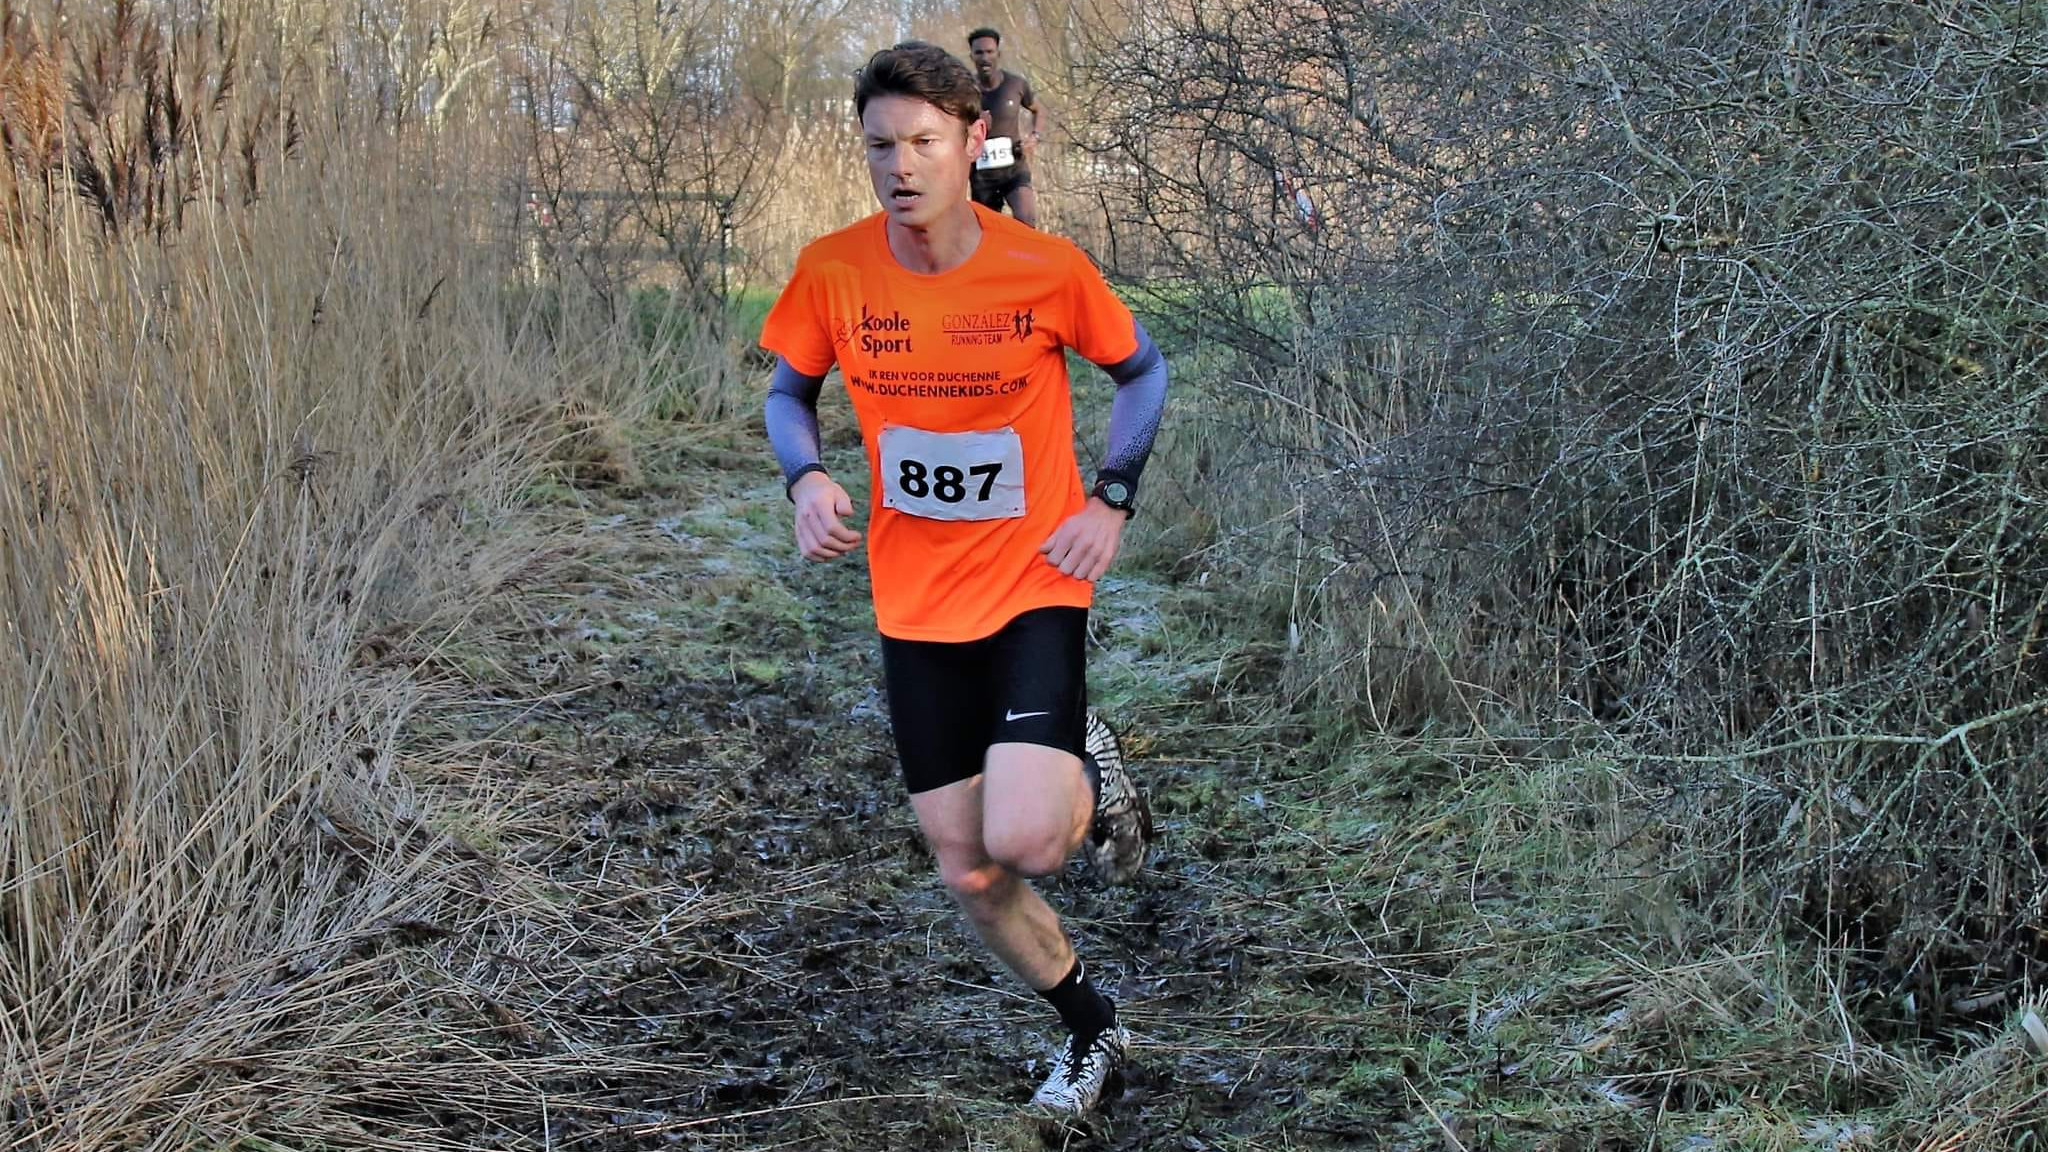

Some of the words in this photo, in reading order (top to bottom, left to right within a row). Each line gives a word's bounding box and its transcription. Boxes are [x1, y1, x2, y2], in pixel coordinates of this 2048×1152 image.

[861, 334, 912, 358] Sport
[951, 334, 983, 345] RUNNING
[983, 333, 1002, 345] TEAM
[868, 370, 878, 379] IK
[879, 371, 899, 380] REN
[901, 372, 935, 382] VOOR
[937, 371, 1001, 382] DUCHENNE
[899, 459, 1003, 503] 887
